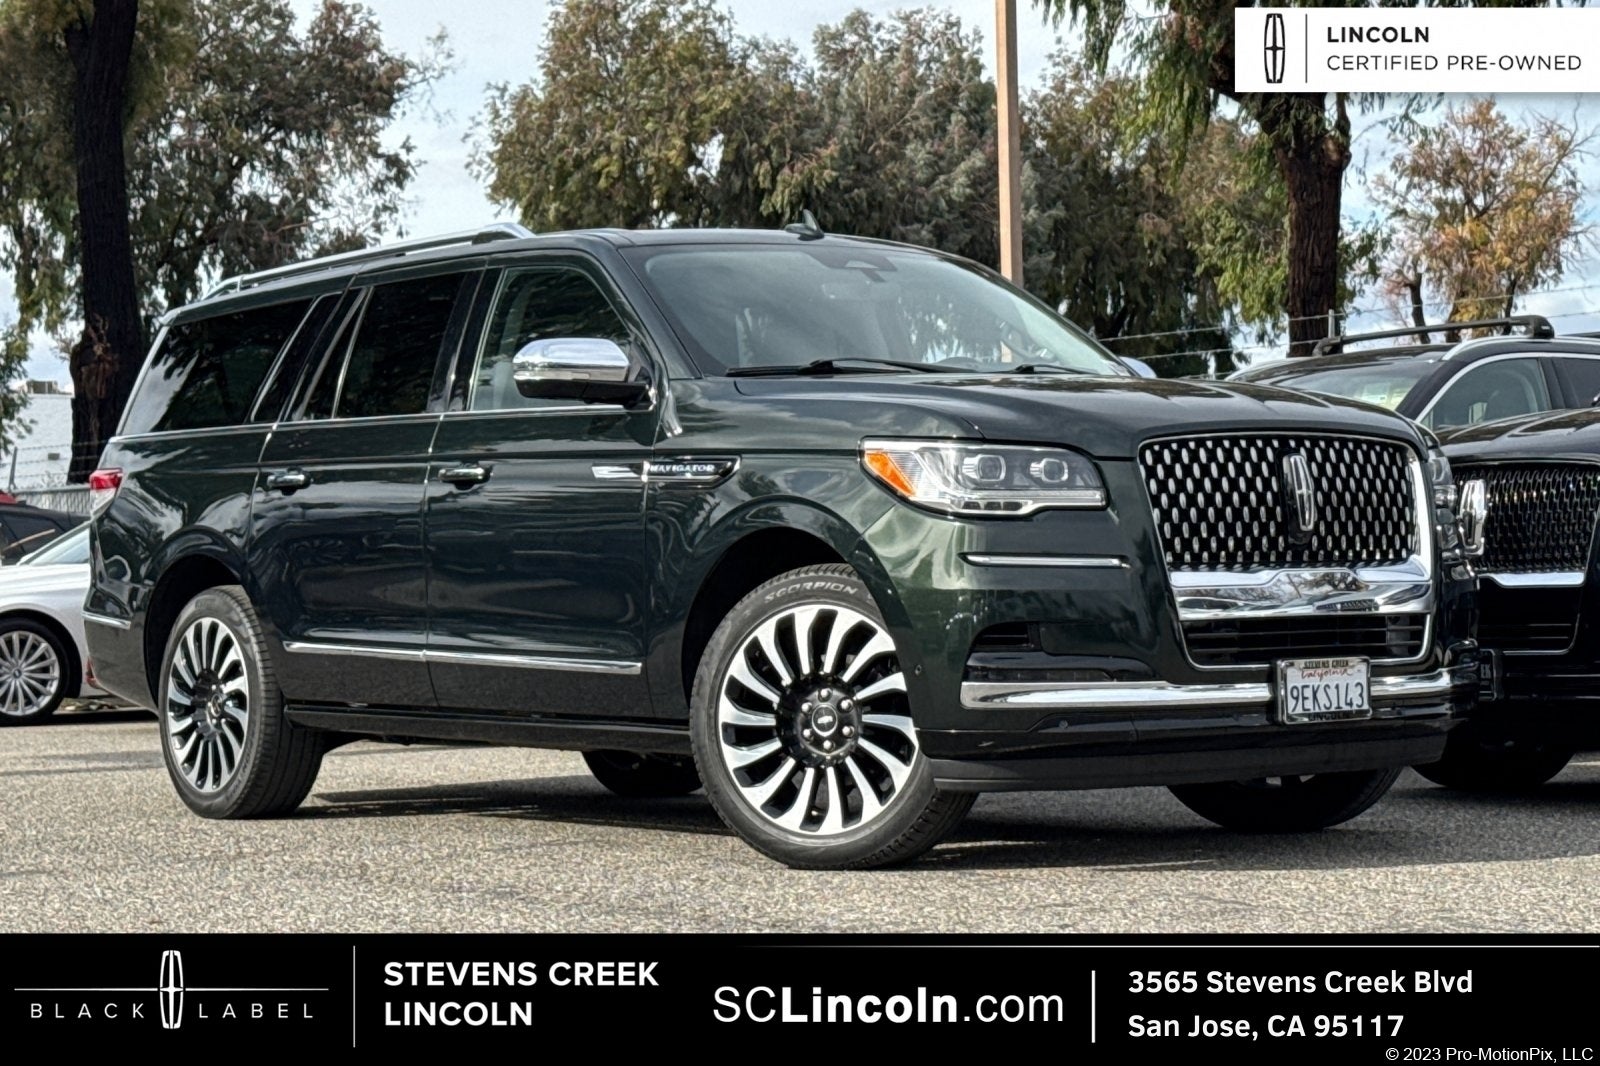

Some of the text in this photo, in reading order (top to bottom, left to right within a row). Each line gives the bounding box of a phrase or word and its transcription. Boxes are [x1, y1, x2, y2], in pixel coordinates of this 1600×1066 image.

[650, 463, 715, 473] NAVIGATOR
[763, 581, 859, 604] SCORPION
[1303, 660, 1329, 670] STEVENS
[1290, 681, 1365, 713] 9EKS143
